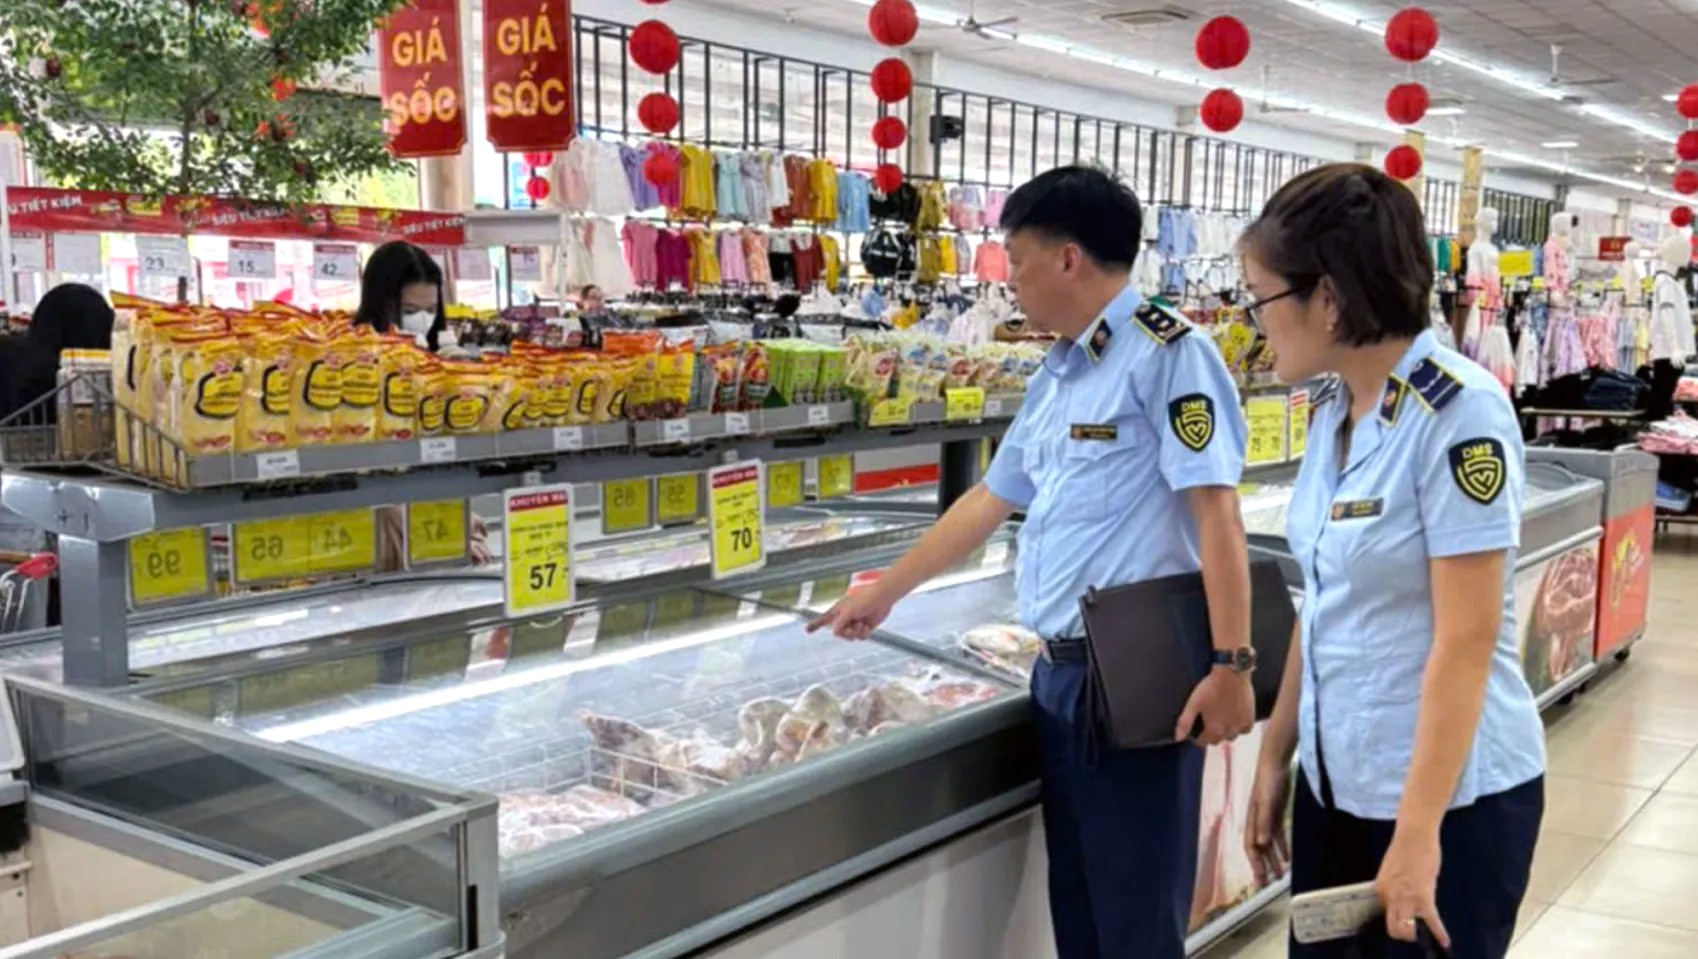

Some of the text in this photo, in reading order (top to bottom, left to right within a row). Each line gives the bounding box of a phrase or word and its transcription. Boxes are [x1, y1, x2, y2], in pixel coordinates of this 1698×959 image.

[392, 16, 448, 66] GIÁ
[497, 3, 557, 56] GIÁ
[391, 72, 457, 126] SỐC
[492, 61, 566, 118] SỐC
[237, 260, 254, 274] 15
[321, 263, 338, 276] 42
[1462, 442, 1493, 459] DMS
[731, 527, 753, 552] 70
[529, 561, 558, 591] 57
